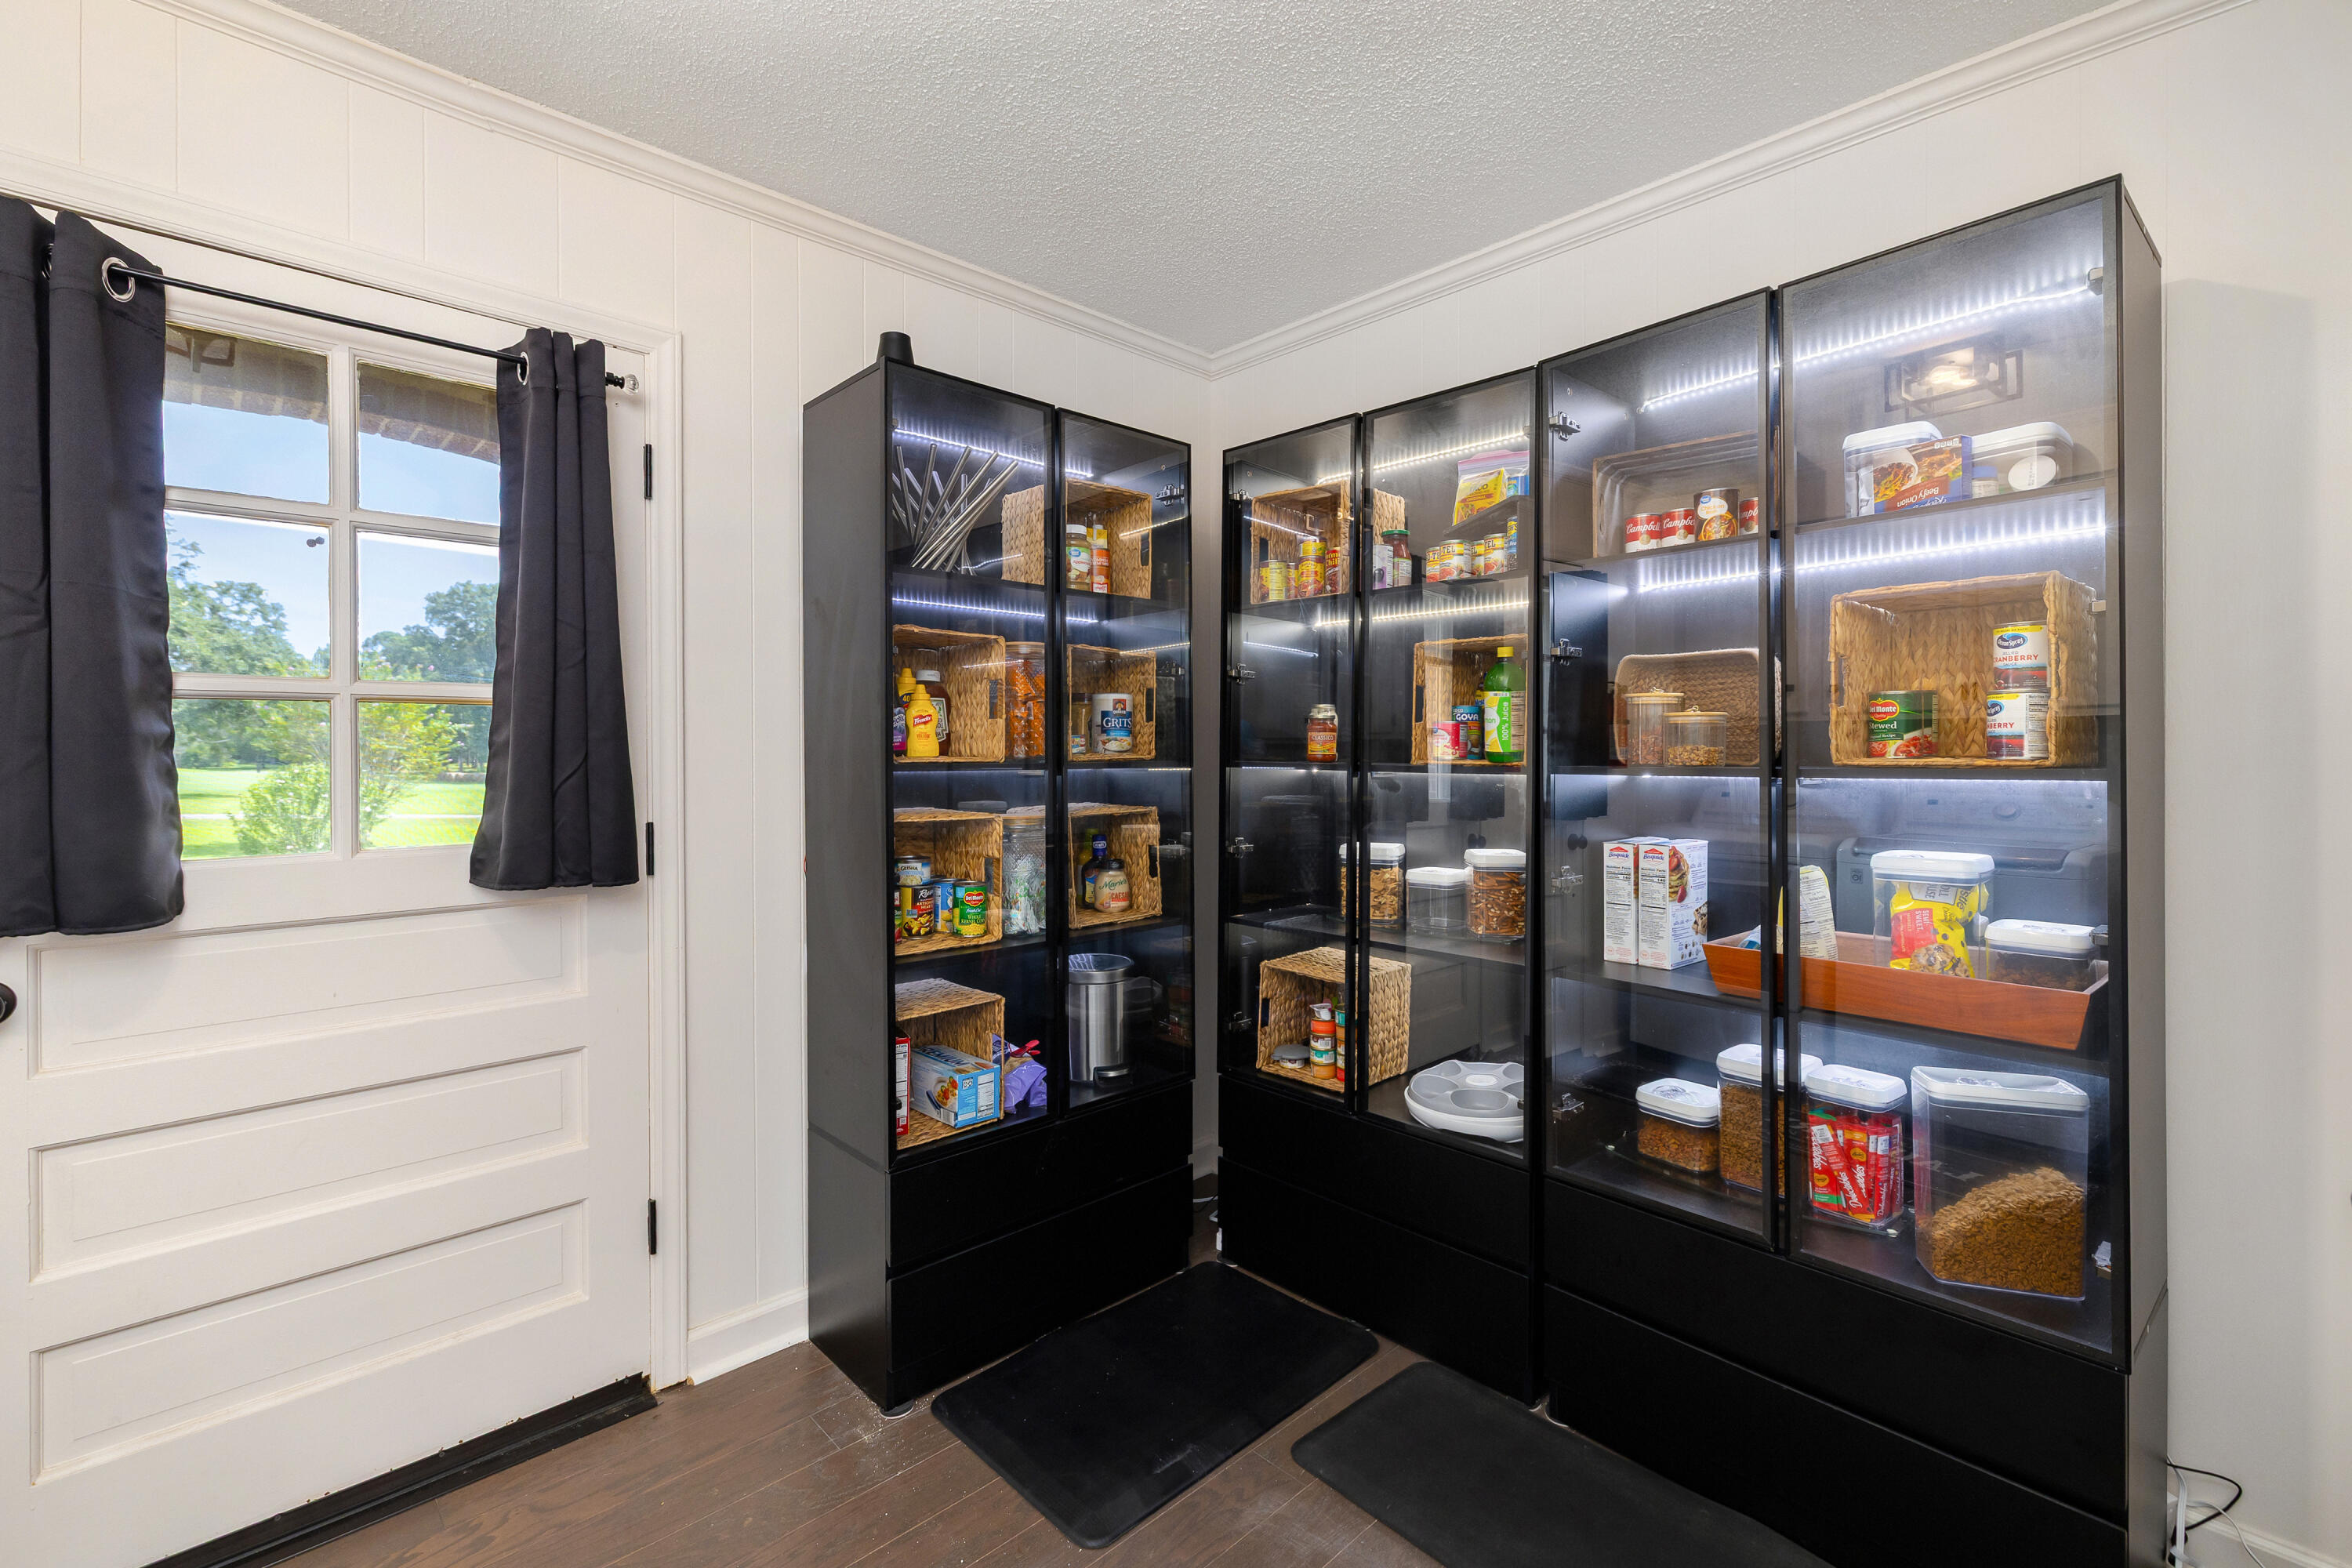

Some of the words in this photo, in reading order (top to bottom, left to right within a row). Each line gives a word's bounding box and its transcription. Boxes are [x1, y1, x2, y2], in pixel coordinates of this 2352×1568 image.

[1918, 486, 1939, 503] Beefy
[1896, 494, 1918, 508] Onion
[2009, 637, 2024, 647] Spray
[1102, 717, 1133, 728] GRITS
[1869, 721, 1897, 730] Stewed
[1098, 877, 1127, 891] Marie's
